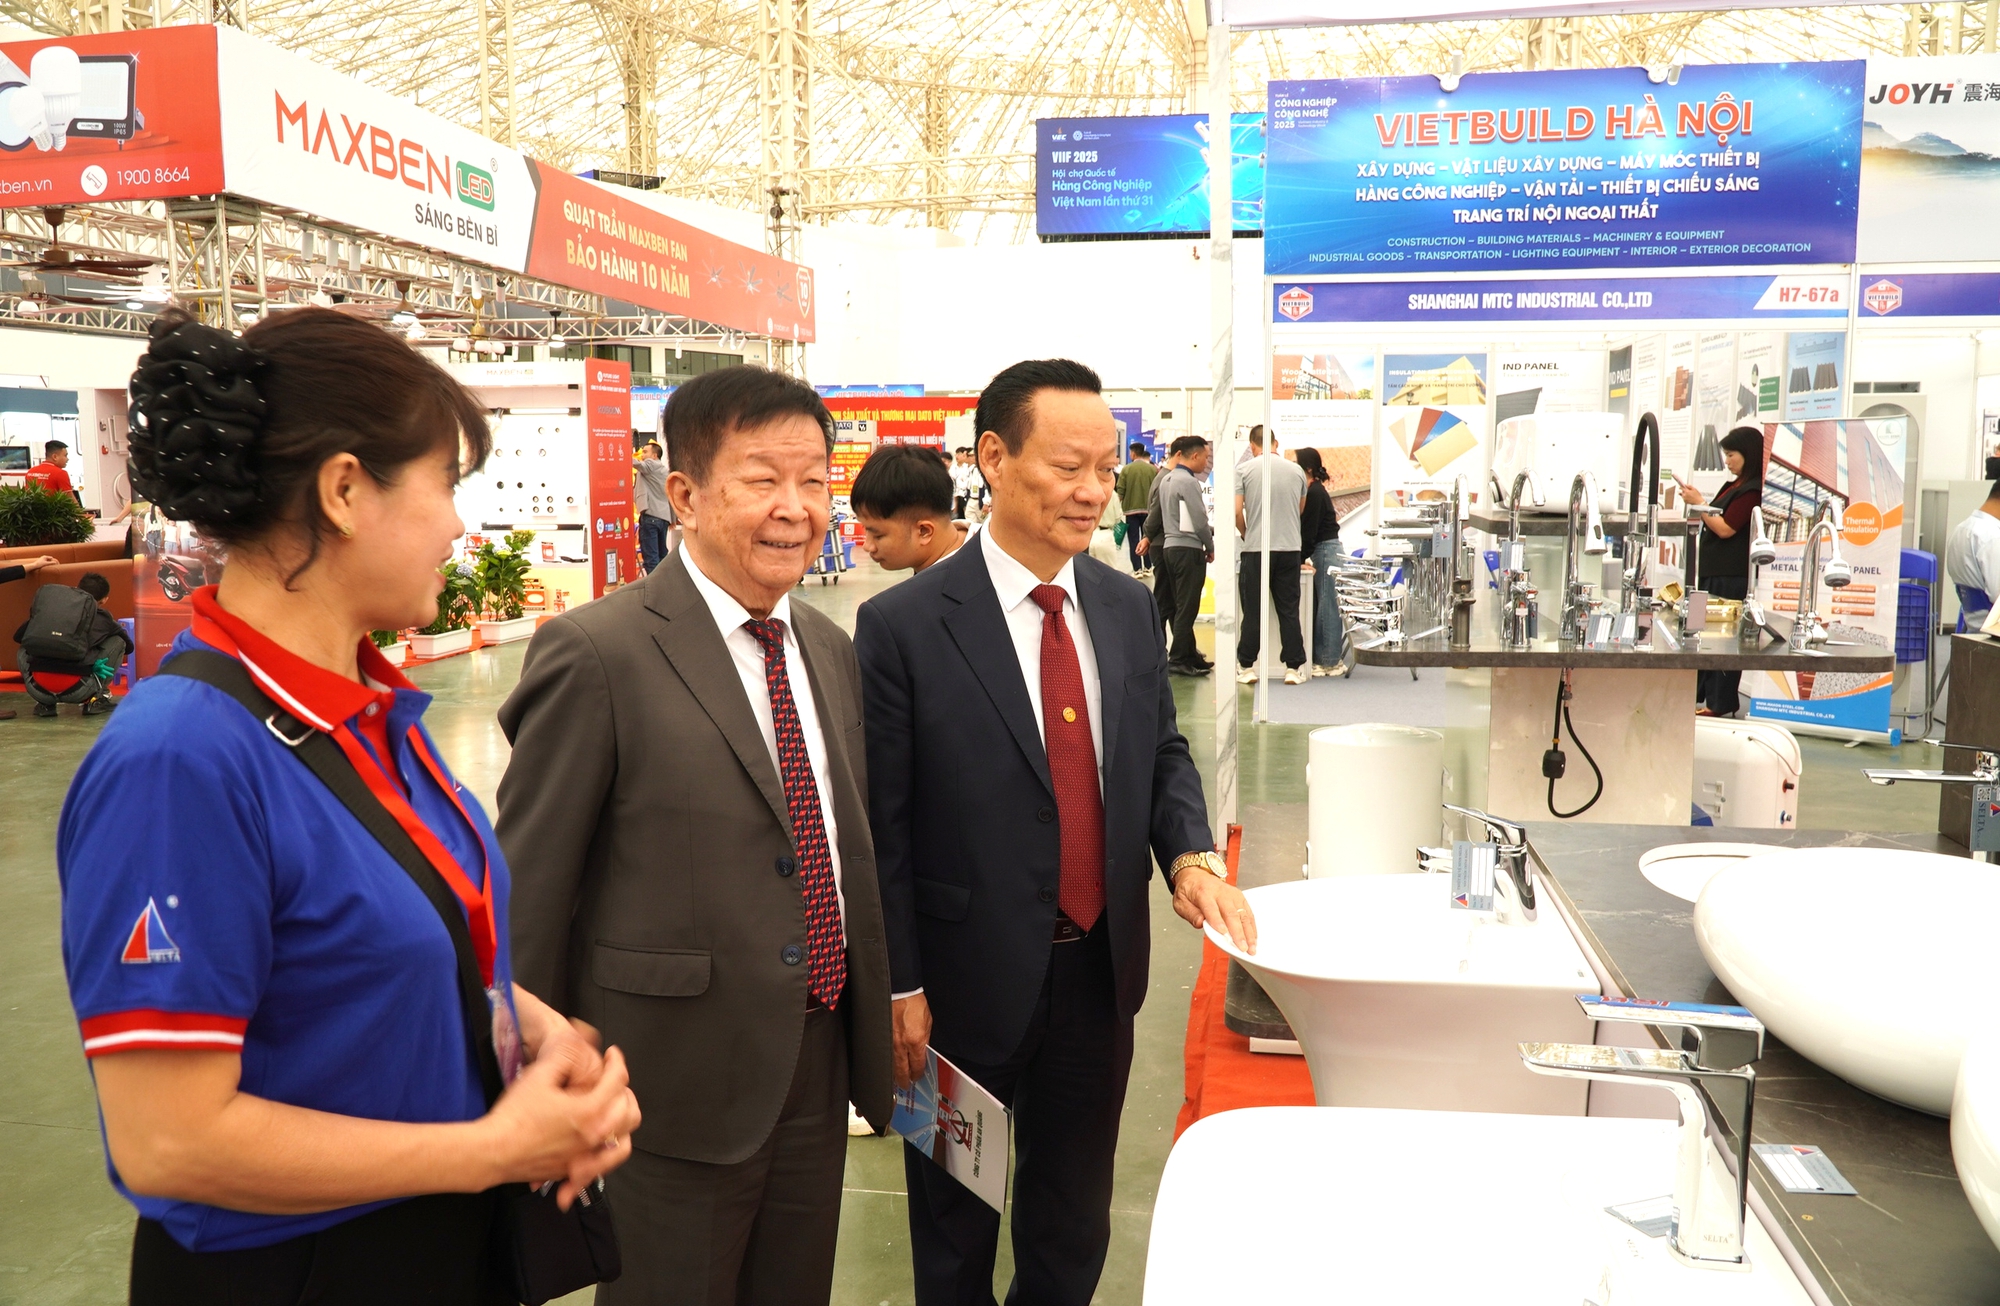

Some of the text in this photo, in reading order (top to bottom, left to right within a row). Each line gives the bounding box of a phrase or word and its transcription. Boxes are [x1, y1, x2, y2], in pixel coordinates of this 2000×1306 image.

[1869, 83, 1954, 104] JOYH
[1274, 97, 1337, 107] CÔNG NGHIỆP
[1274, 108, 1329, 118] CÔNG NGHỆ
[1374, 91, 1754, 148] VIETBUILD HÀ NỘI
[275, 88, 494, 204] MAXBEN LED
[1052, 151, 1098, 163] VIIF 2025
[1357, 146, 1760, 178] XÂY DỰNG VẬT LIỆU XÂY DỰNG MÁY MÓC THIẾT BỊ
[116, 167, 190, 186] 1900 8664
[1052, 166, 1116, 179] Hội chợ Quốc tế
[1052, 178, 1152, 193] Hàng Công Nghiệp
[1355, 171, 1760, 202] HÀNG CÔNG NGHIỆP VẬN TẢI THIẾT BỊ CHIẾU SÁNG
[1052, 194, 1153, 209] Việt Nam lần thứ 31
[415, 202, 453, 232] SÁNG
[1453, 198, 1659, 225] TRANG TRÍ NỘI NGOẠI THẤT
[563, 199, 688, 262] QUẠT TRẦN MAXBEN FAN
[1387, 230, 1725, 247] CONSTRUCTION BUILDING MATERIALS MACHINERY & EQUIPMENT
[1309, 242, 1811, 263] INDUSTRIAL GOODS TRANSPORTATION LIGHTING EQUIPMENT INTERIOR EXTERIOR DECORATION
[566, 233, 690, 299] BẢO HÀNH 10 NĂM
[1408, 291, 1653, 310] SHANGHAI MTC INDUSTRIAL CO.,LTD
[1778, 287, 1840, 302] H7-67a
[1524, 362, 1560, 370] PANEL
[1617, 368, 1631, 384] PANEL
[905, 410, 916, 423] MẠI
[918, 410, 932, 421] DATO
[933, 409, 945, 423] VIỆT
[1846, 517, 1875, 525] Thermal
[1771, 564, 1799, 572] METAL
[1854, 566, 1881, 575] PANEL
[1978, 802, 1986, 832] SELTA
[974, 1156, 980, 1164] TY
[1703, 1234, 1729, 1244] SELTA
